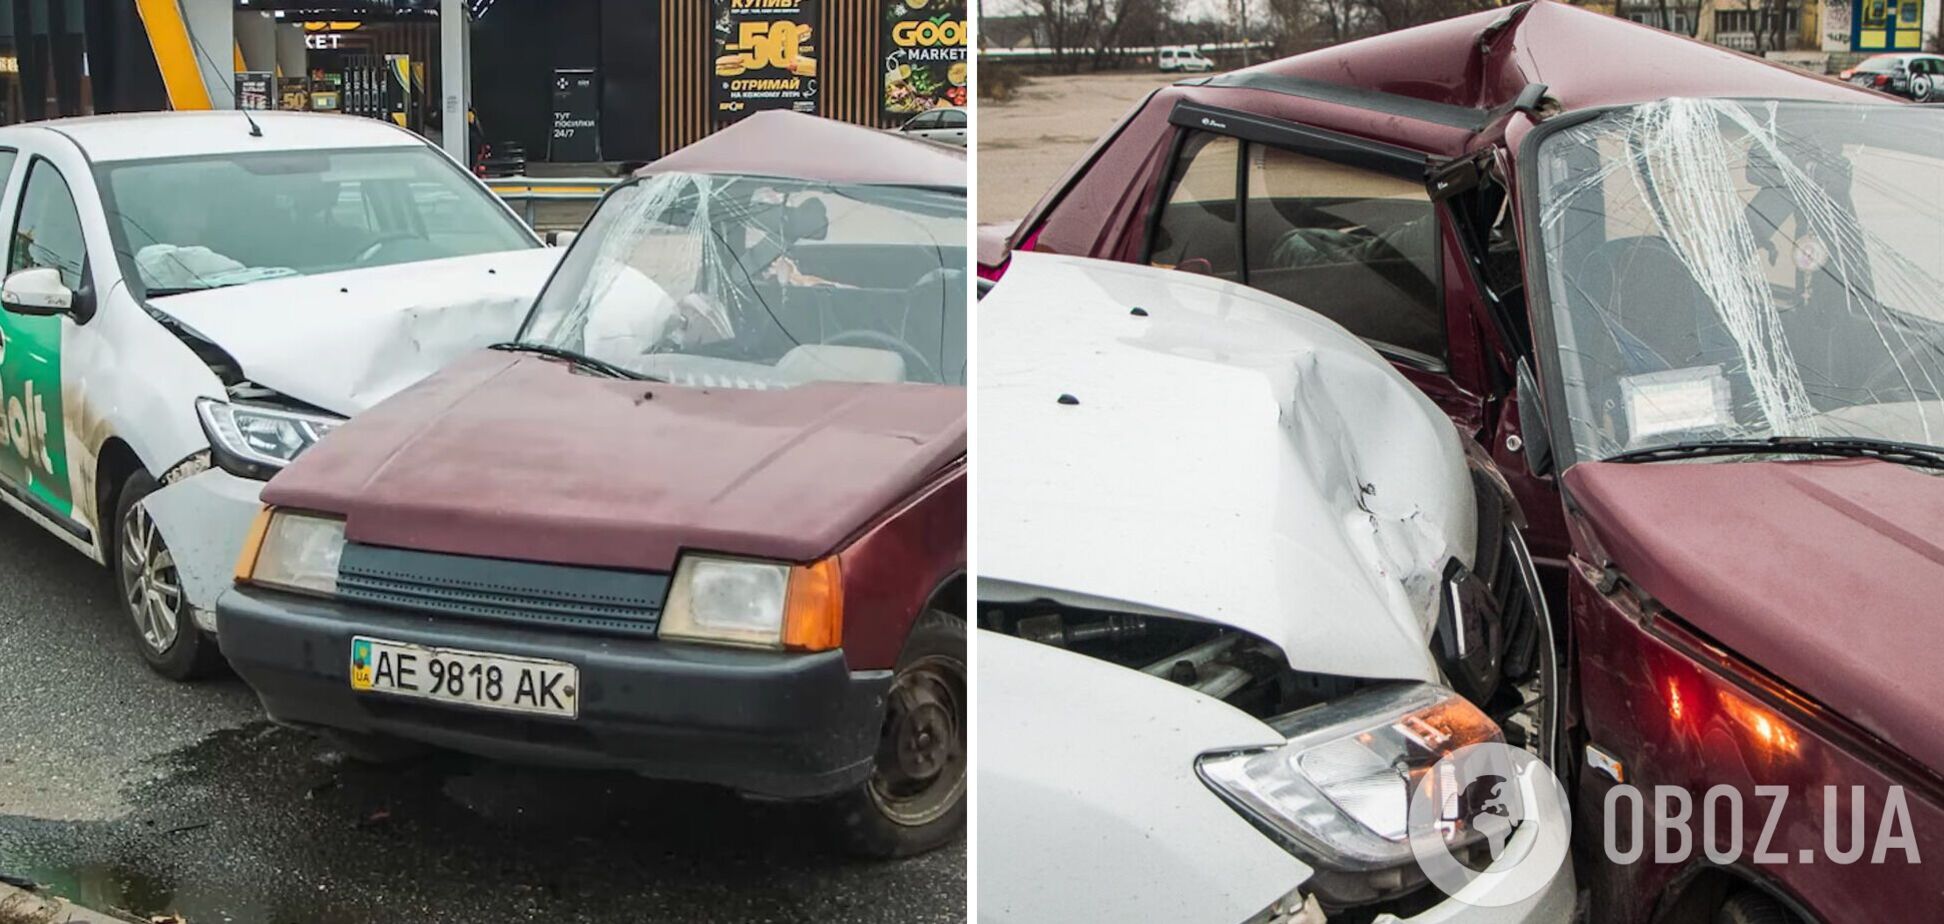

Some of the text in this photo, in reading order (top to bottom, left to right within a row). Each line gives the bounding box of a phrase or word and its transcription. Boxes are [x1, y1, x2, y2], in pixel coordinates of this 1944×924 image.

[908, 49, 967, 60] MARKET
[731, 77, 800, 90] ОТРИМАЙ
[554, 129, 575, 138] 24/7
[0, 379, 54, 475] olt
[356, 673, 370, 683] UA
[373, 651, 565, 709] AE 9818 AK
